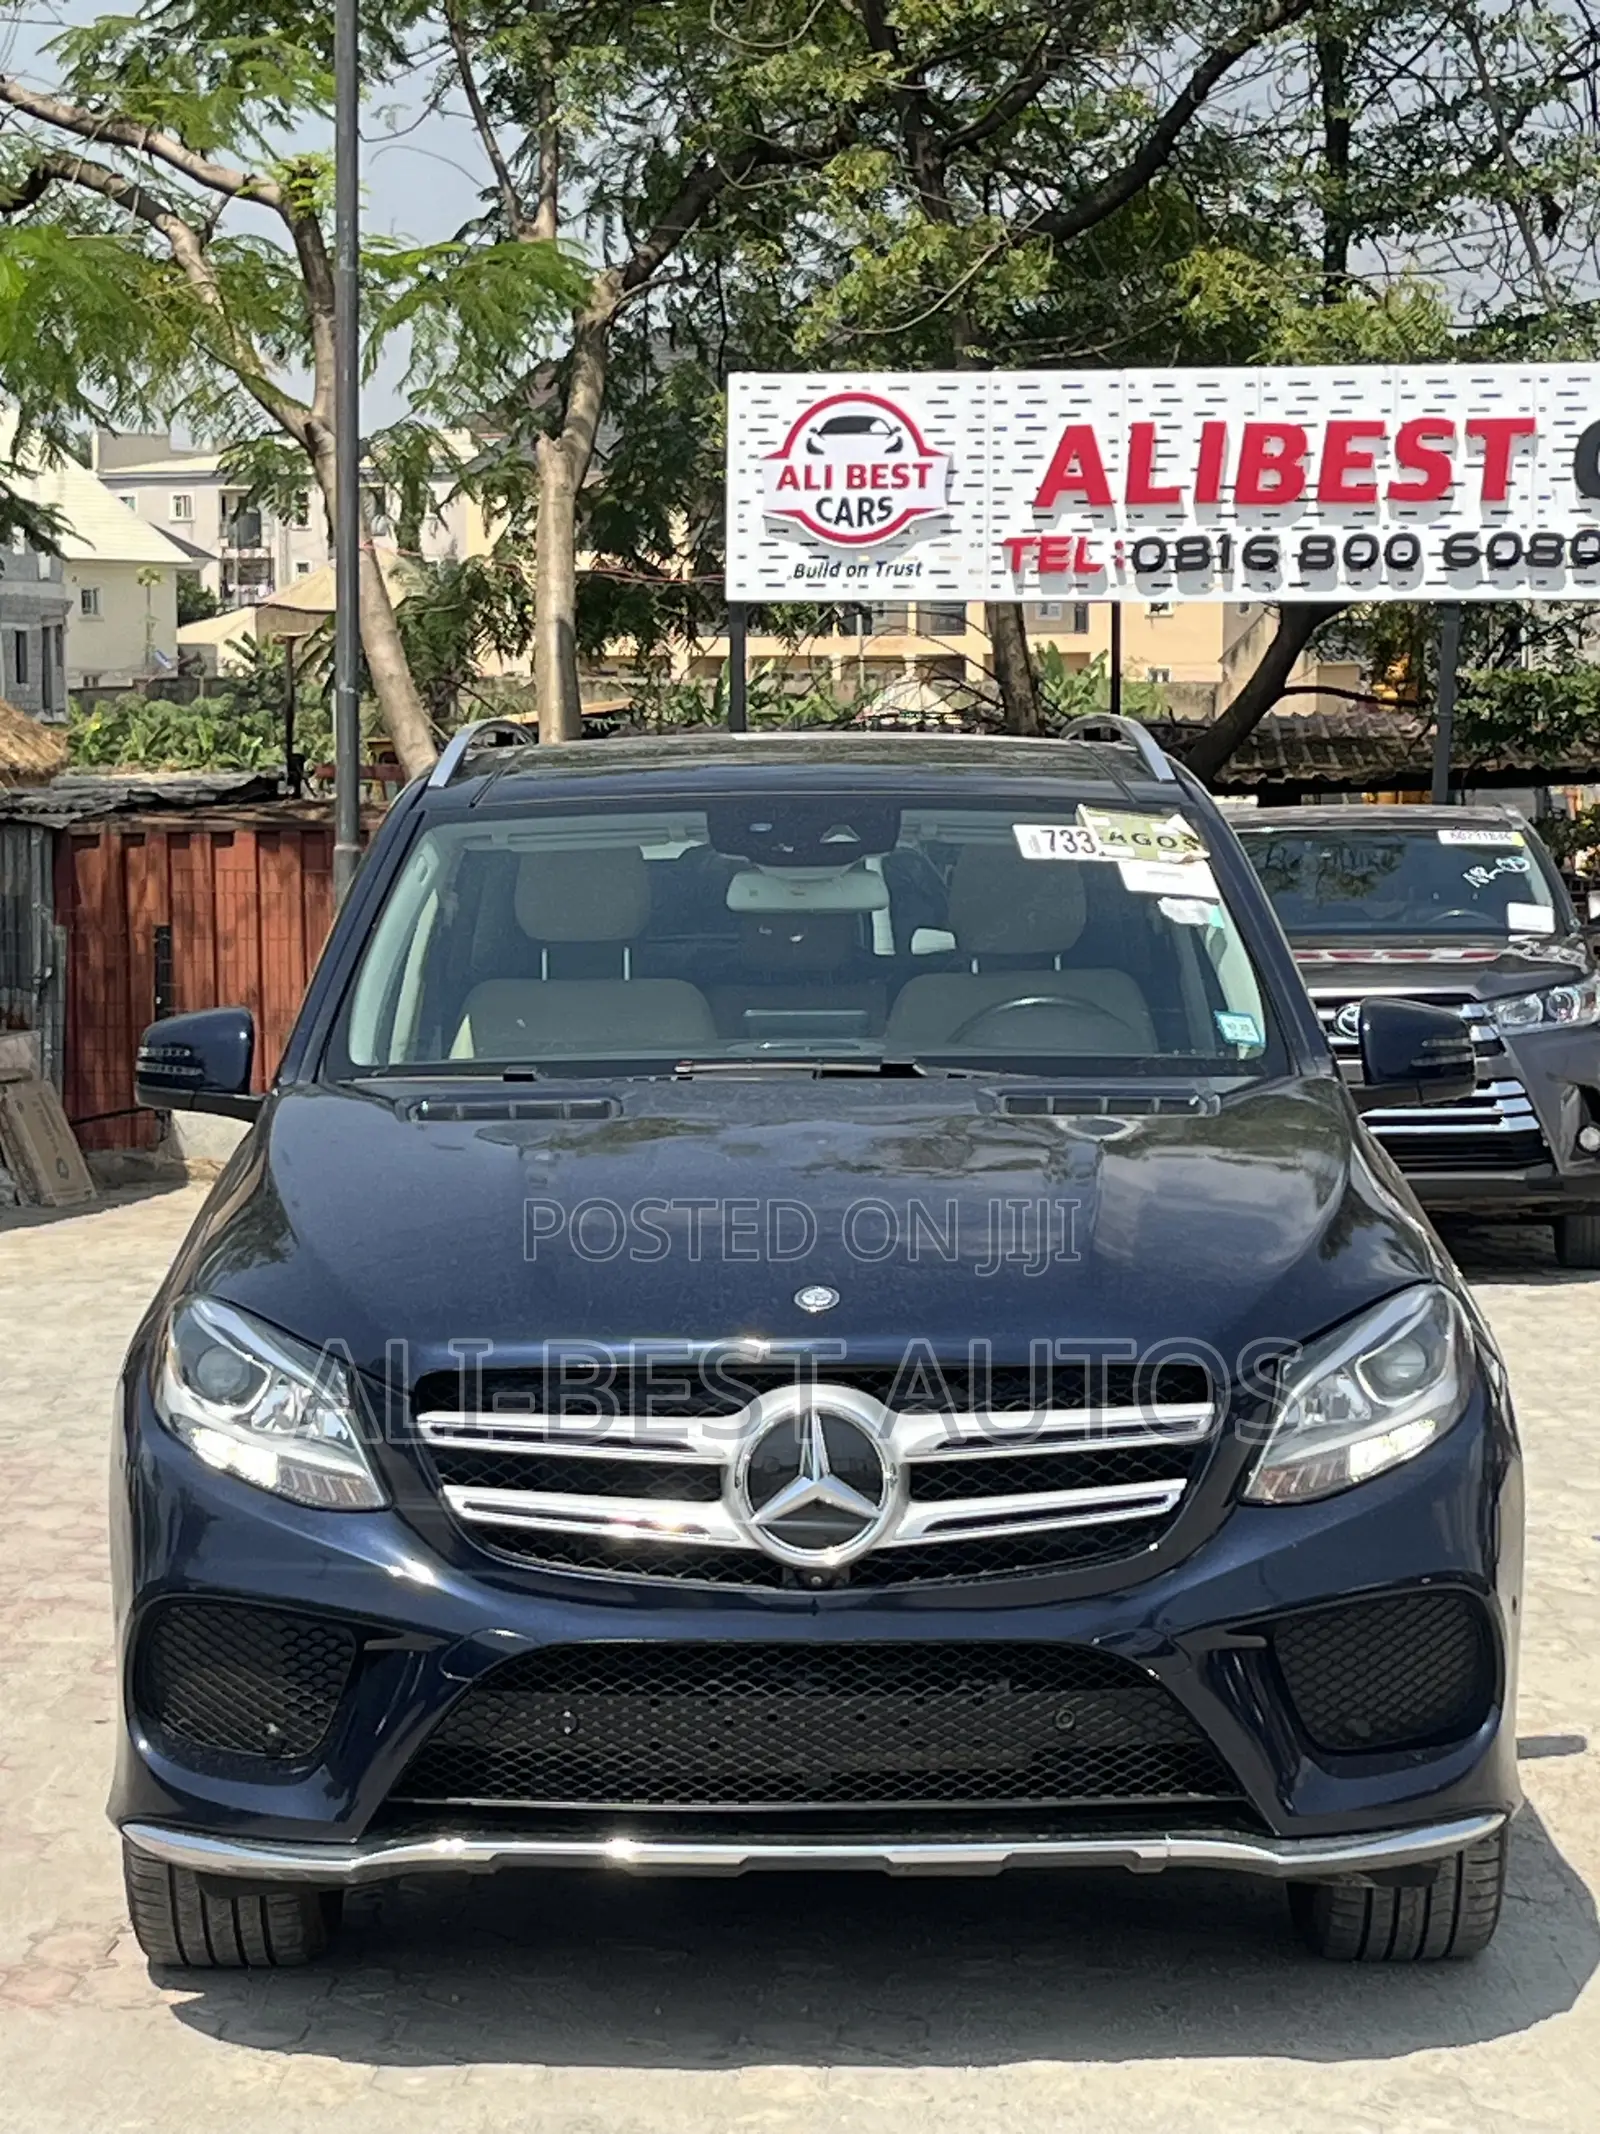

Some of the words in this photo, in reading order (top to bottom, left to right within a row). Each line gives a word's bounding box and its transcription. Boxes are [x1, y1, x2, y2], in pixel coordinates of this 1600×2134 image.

[776, 464, 832, 491] ALI
[846, 462, 934, 490] BEST
[1033, 417, 1536, 507] ALIBEST
[815, 496, 893, 528] CARS
[1131, 533, 1280, 573] 0816
[1298, 532, 1422, 571] 800
[793, 560, 842, 579] Build
[846, 565, 868, 578] on
[875, 560, 923, 578] Trust
